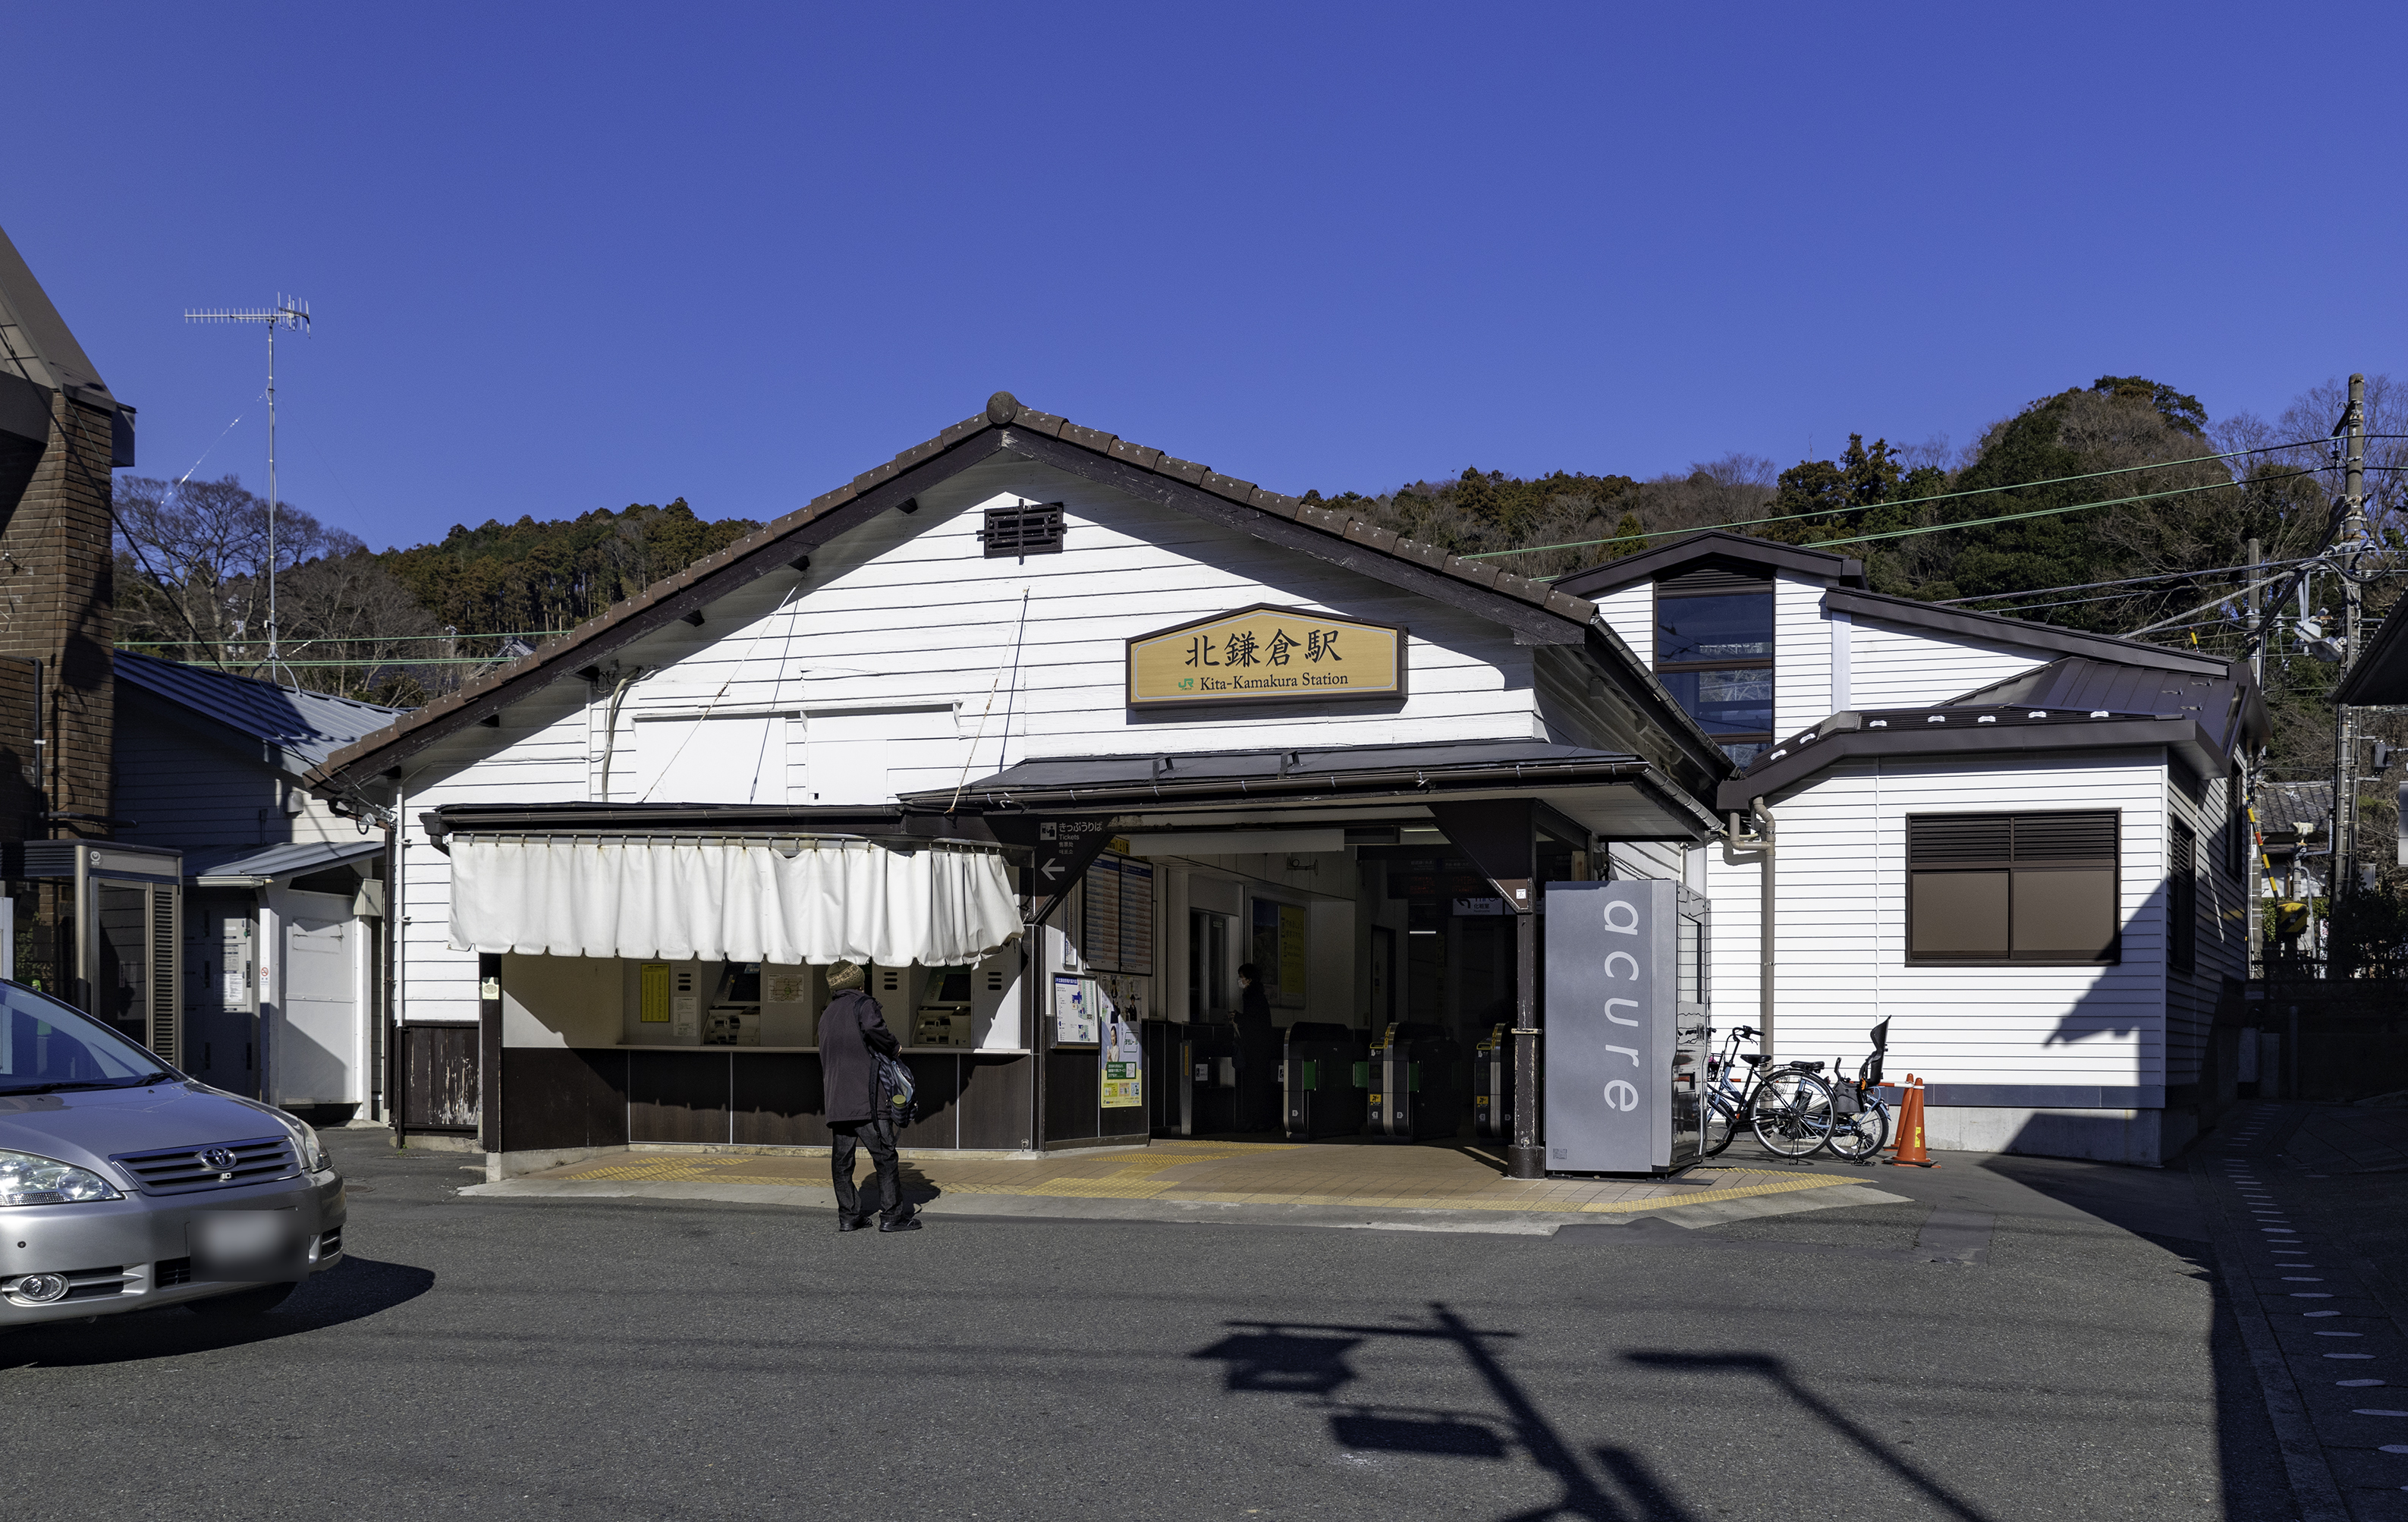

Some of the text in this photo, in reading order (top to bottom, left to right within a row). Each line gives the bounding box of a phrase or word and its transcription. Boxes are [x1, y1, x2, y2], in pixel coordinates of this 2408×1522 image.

[1185, 628, 1343, 668] 北鎌倉駅
[1178, 678, 1194, 688] JR
[1200, 671, 1349, 691] Kita-Kamakura Station
[1058, 821, 1103, 832] きっぷうりば
[1603, 900, 1639, 1112] acure
